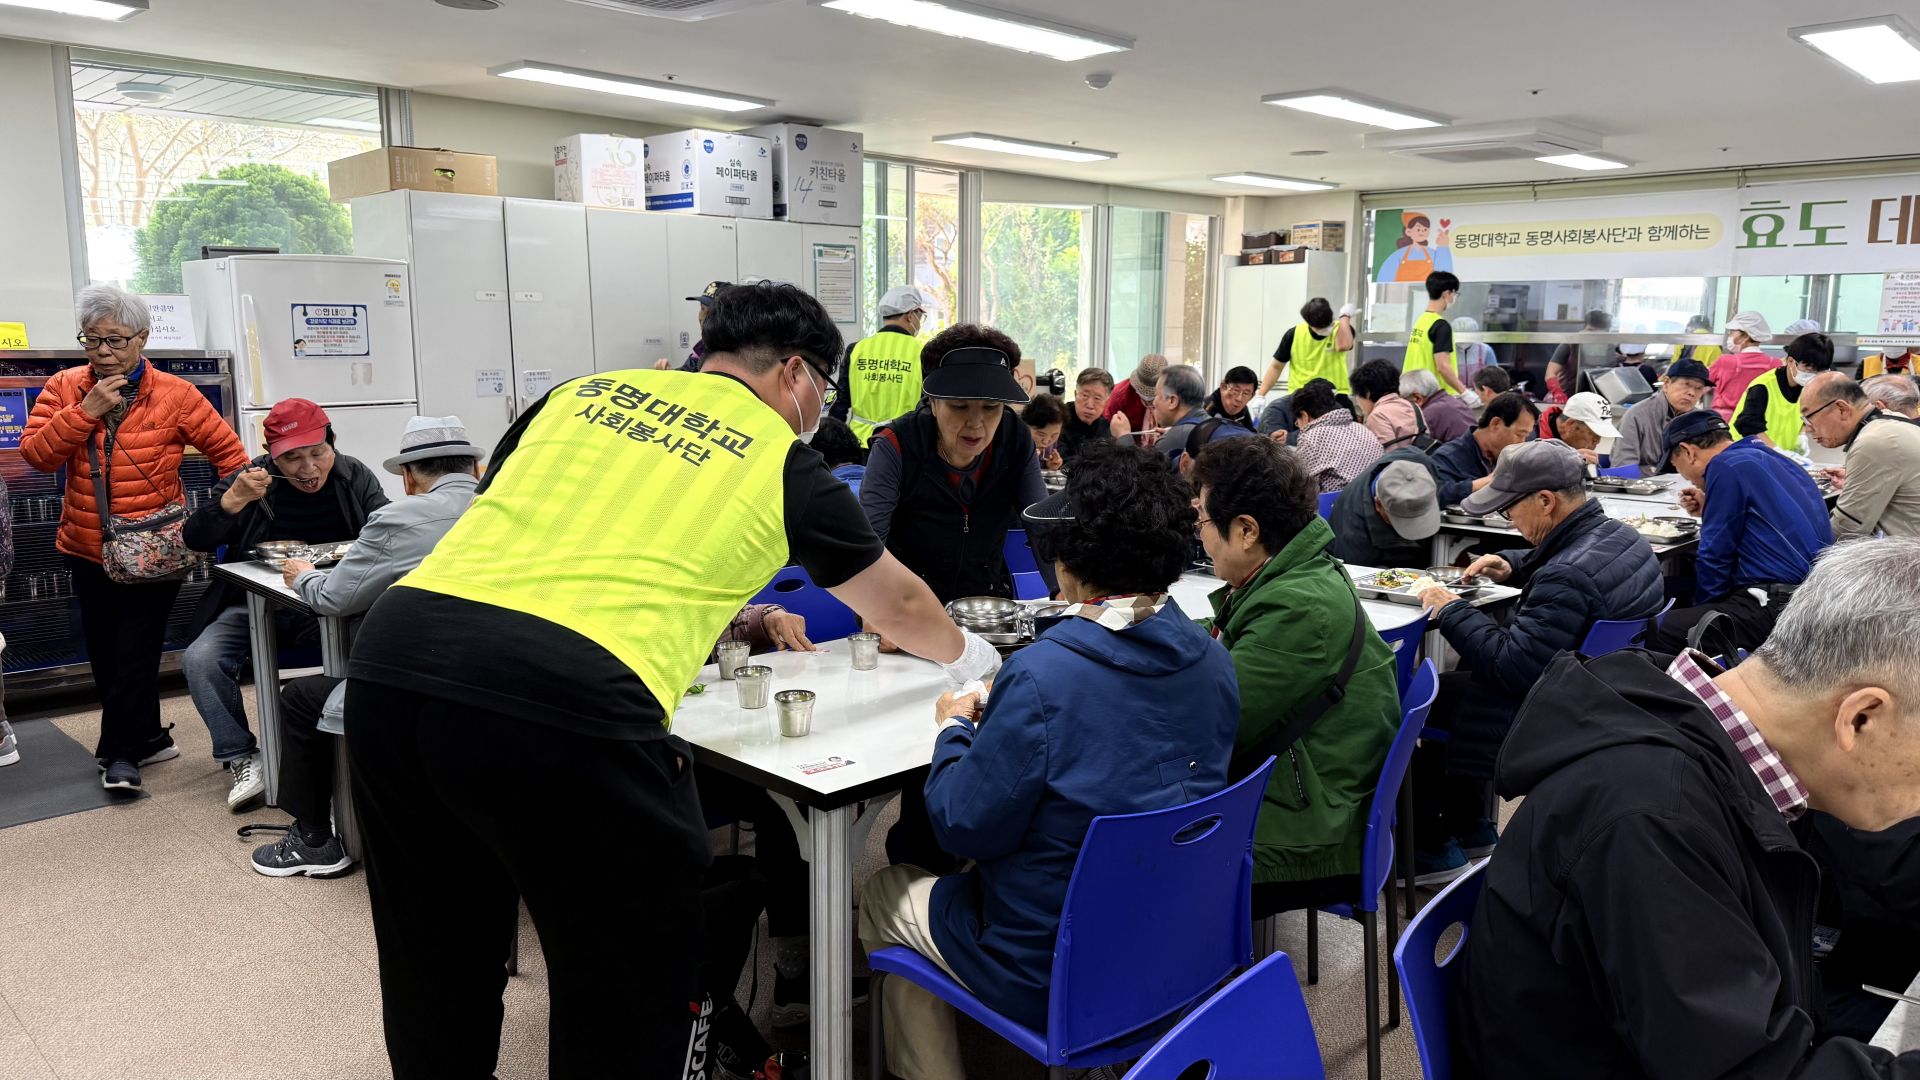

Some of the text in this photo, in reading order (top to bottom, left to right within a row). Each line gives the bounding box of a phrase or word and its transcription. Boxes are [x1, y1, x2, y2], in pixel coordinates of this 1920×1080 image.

[729, 158, 741, 167] 실속
[715, 166, 758, 182] 페이퍼타올
[809, 166, 846, 183] 키친타올
[794, 176, 813, 204] 14
[1736, 200, 1848, 249] 효도
[1454, 223, 1711, 249] 동명대학교 동명사회봉사단과 함께하는
[857, 358, 912, 373] 동명대학교
[864, 372, 903, 383] 사회봉사단
[575, 378, 754, 459] 동명대학교
[575, 403, 712, 467] 사회봉사단
